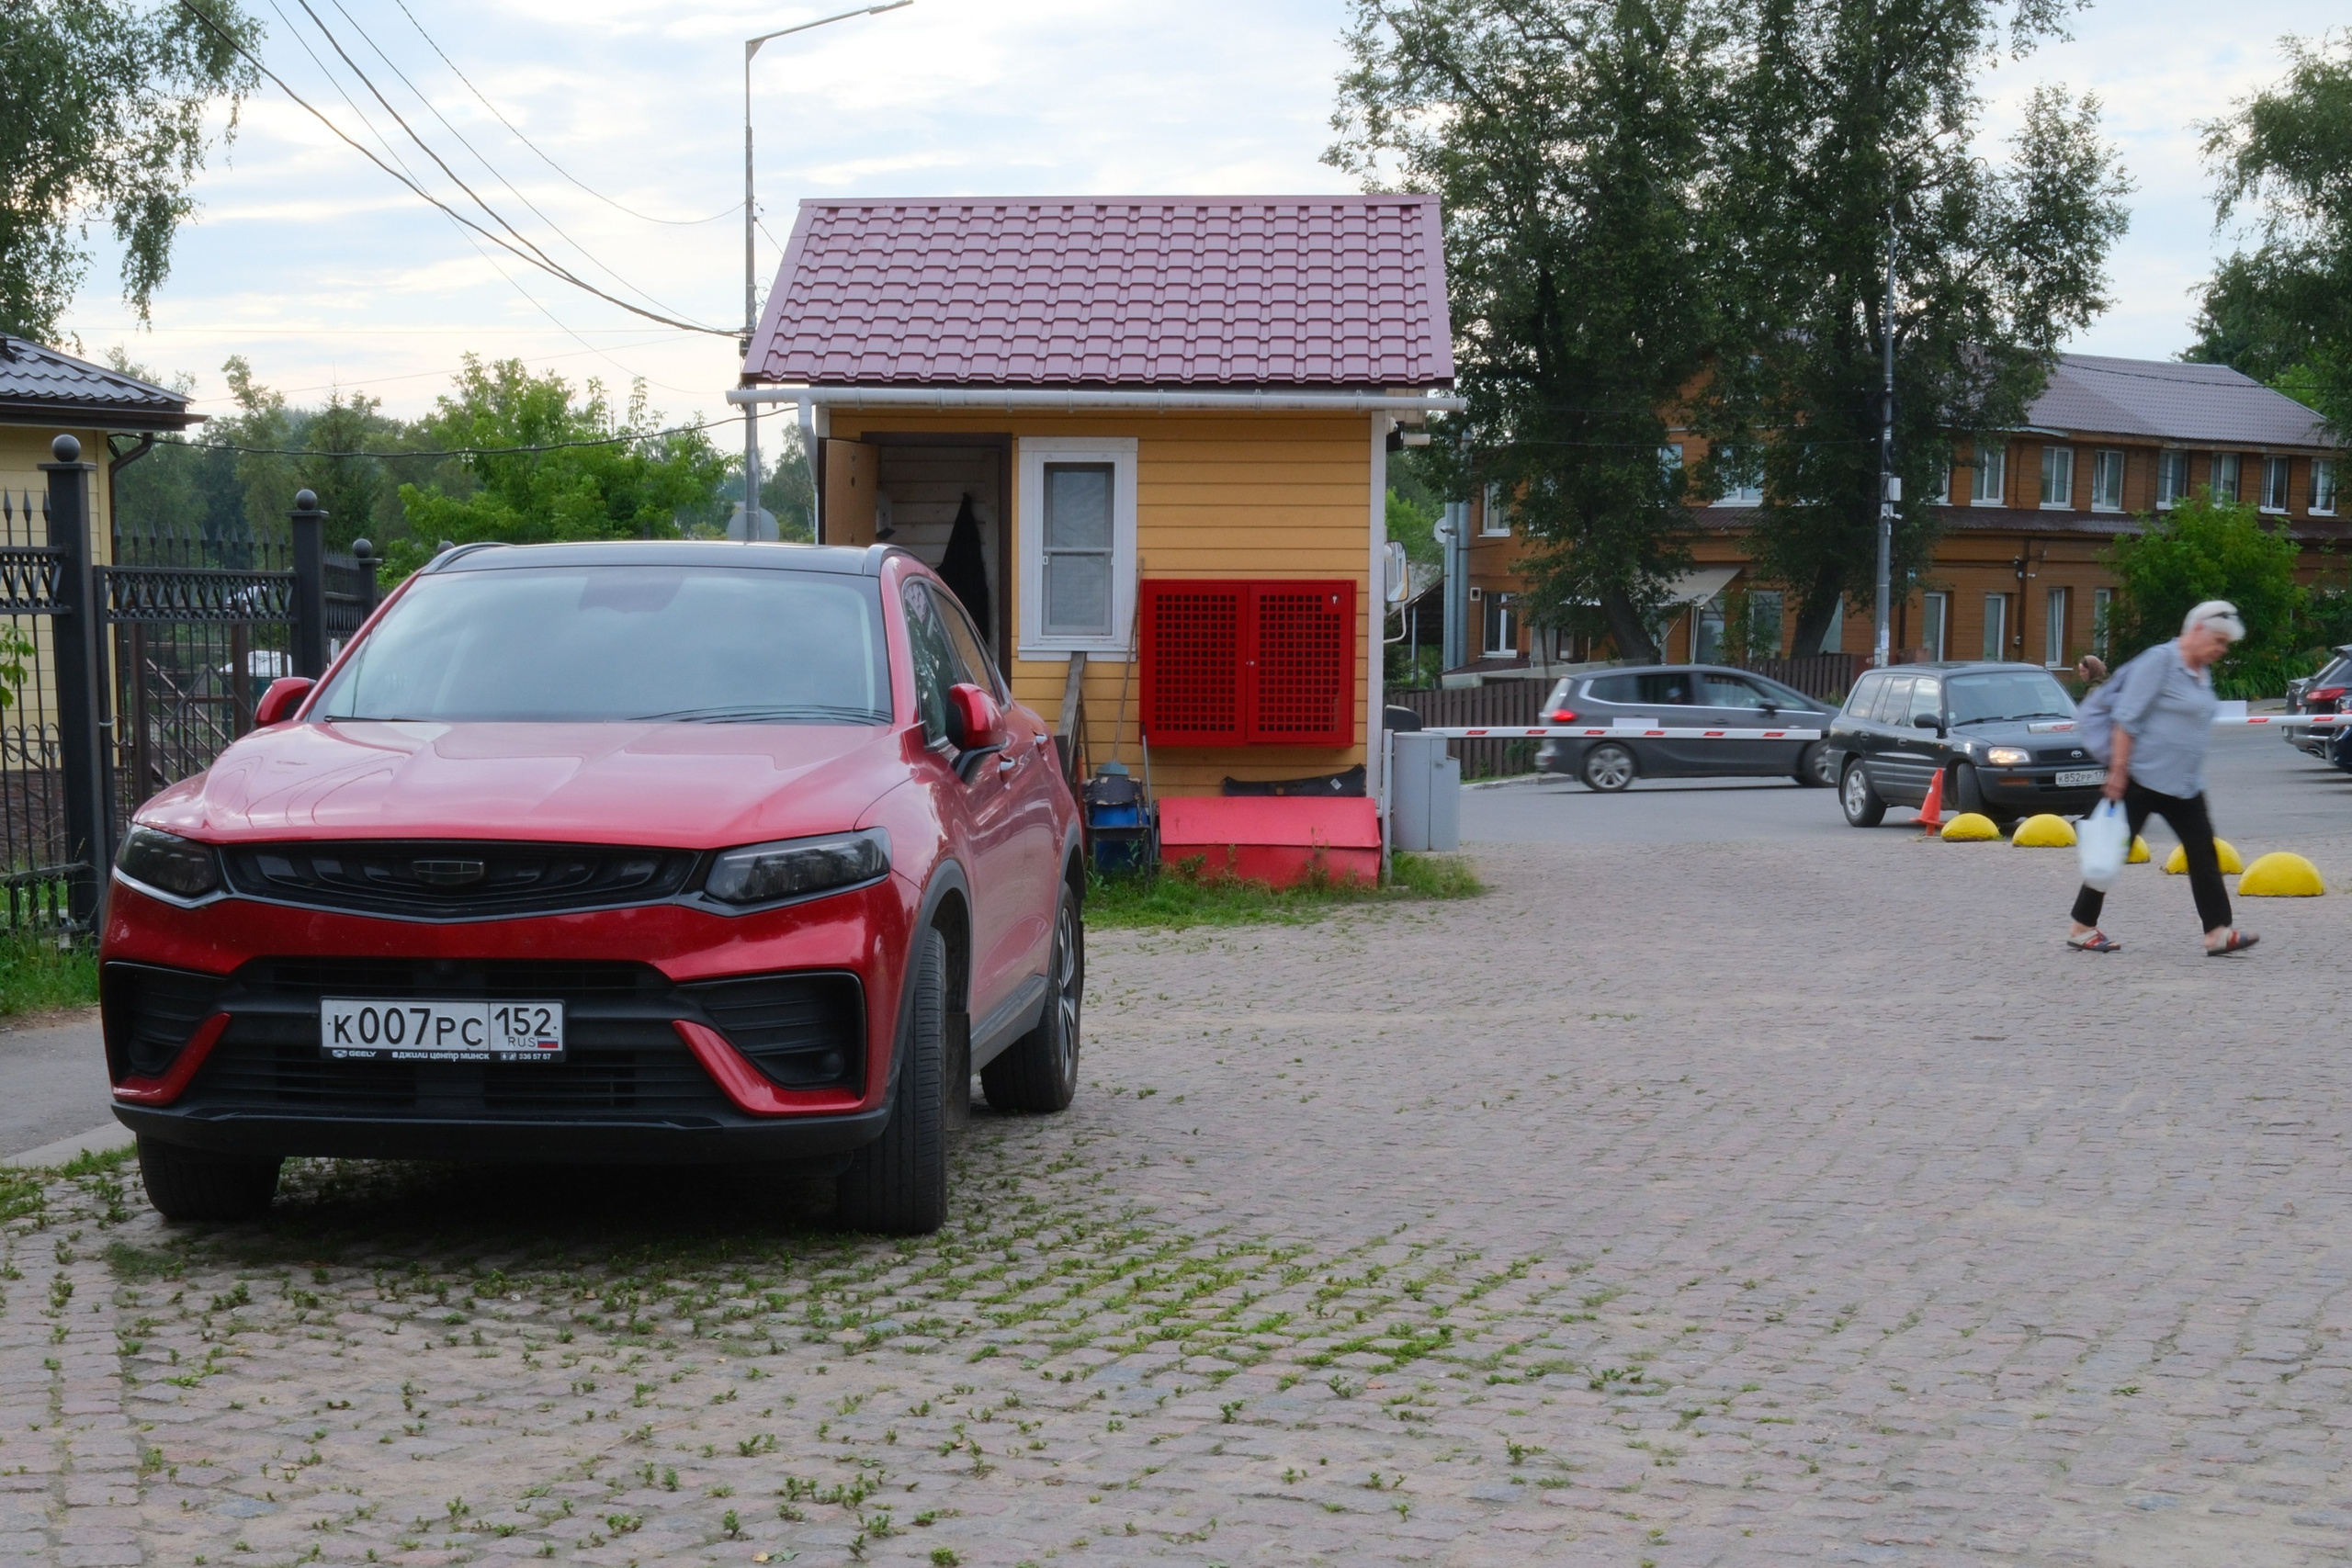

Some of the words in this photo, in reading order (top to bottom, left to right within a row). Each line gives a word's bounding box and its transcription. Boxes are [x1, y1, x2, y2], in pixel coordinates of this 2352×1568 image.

[334, 1007, 483, 1045] К007РС
[494, 1008, 551, 1036] 152
[507, 1037, 536, 1047] RUS
